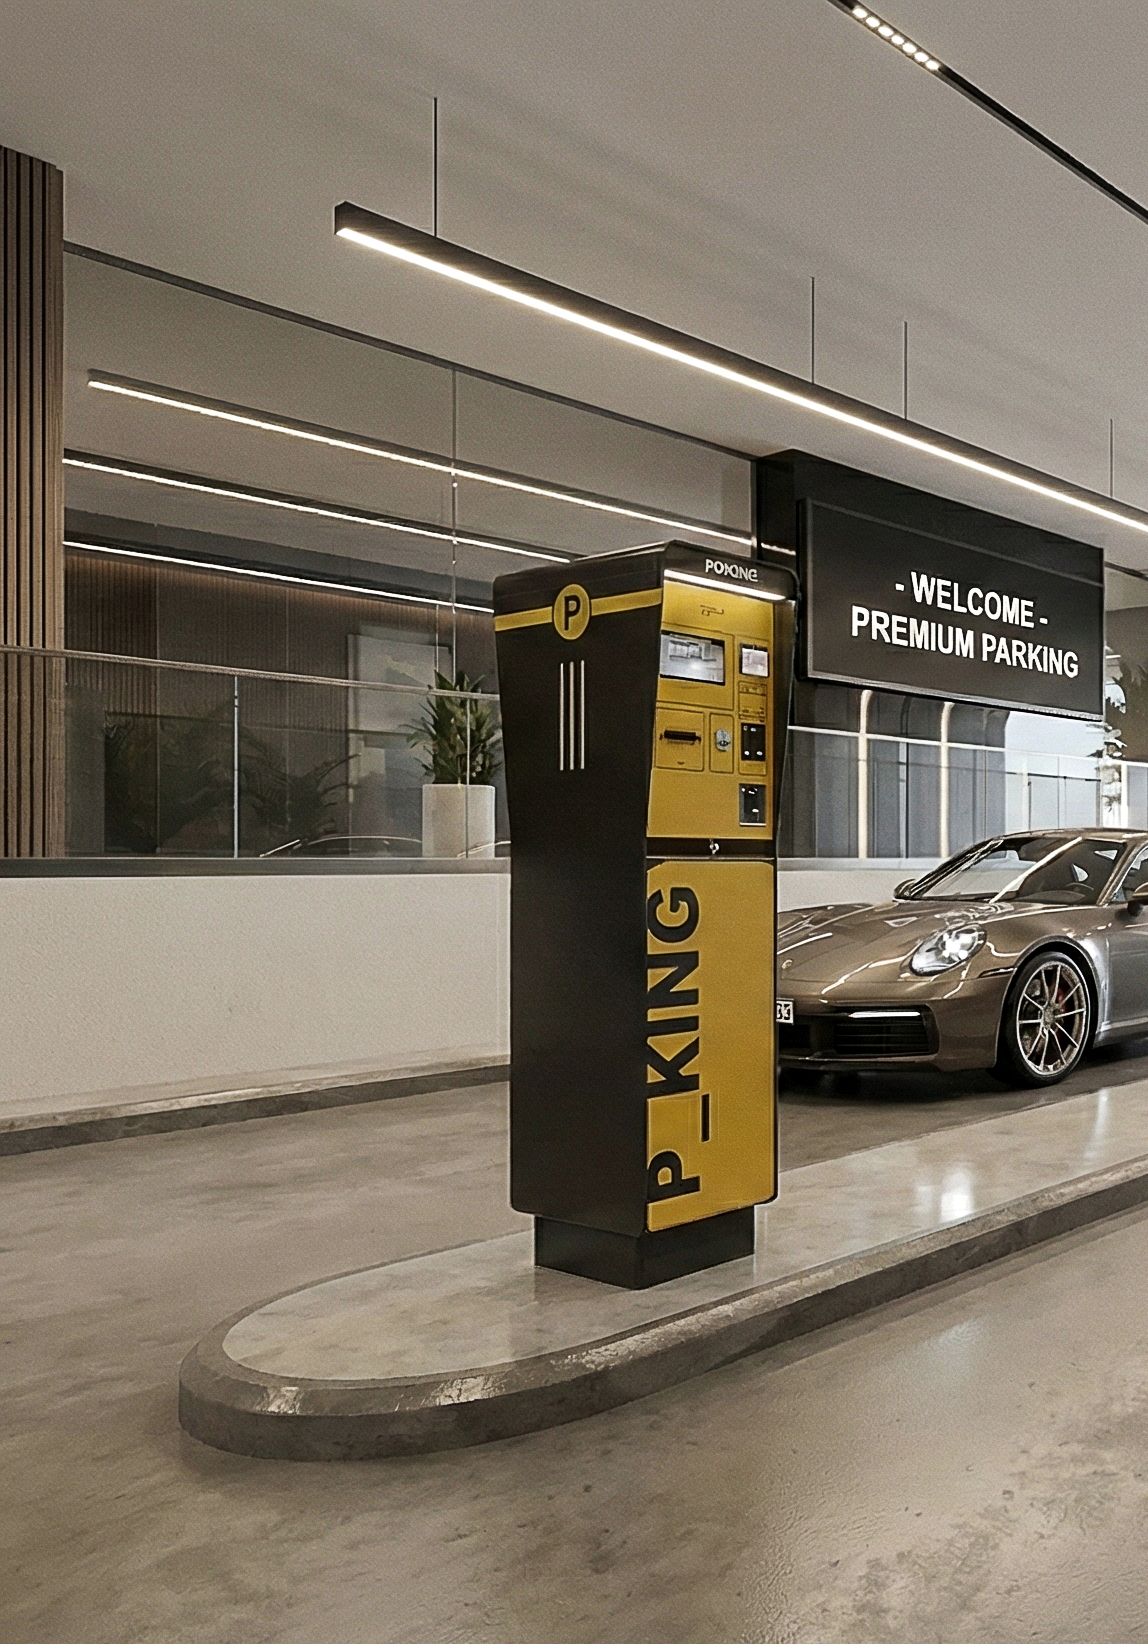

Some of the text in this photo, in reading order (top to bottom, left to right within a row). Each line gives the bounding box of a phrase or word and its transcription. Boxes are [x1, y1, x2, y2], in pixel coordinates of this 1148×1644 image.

[564, 594, 581, 631] P
[910, 571, 1035, 629] WELCOME
[851, 604, 1079, 678] PREMIUM PARKING
